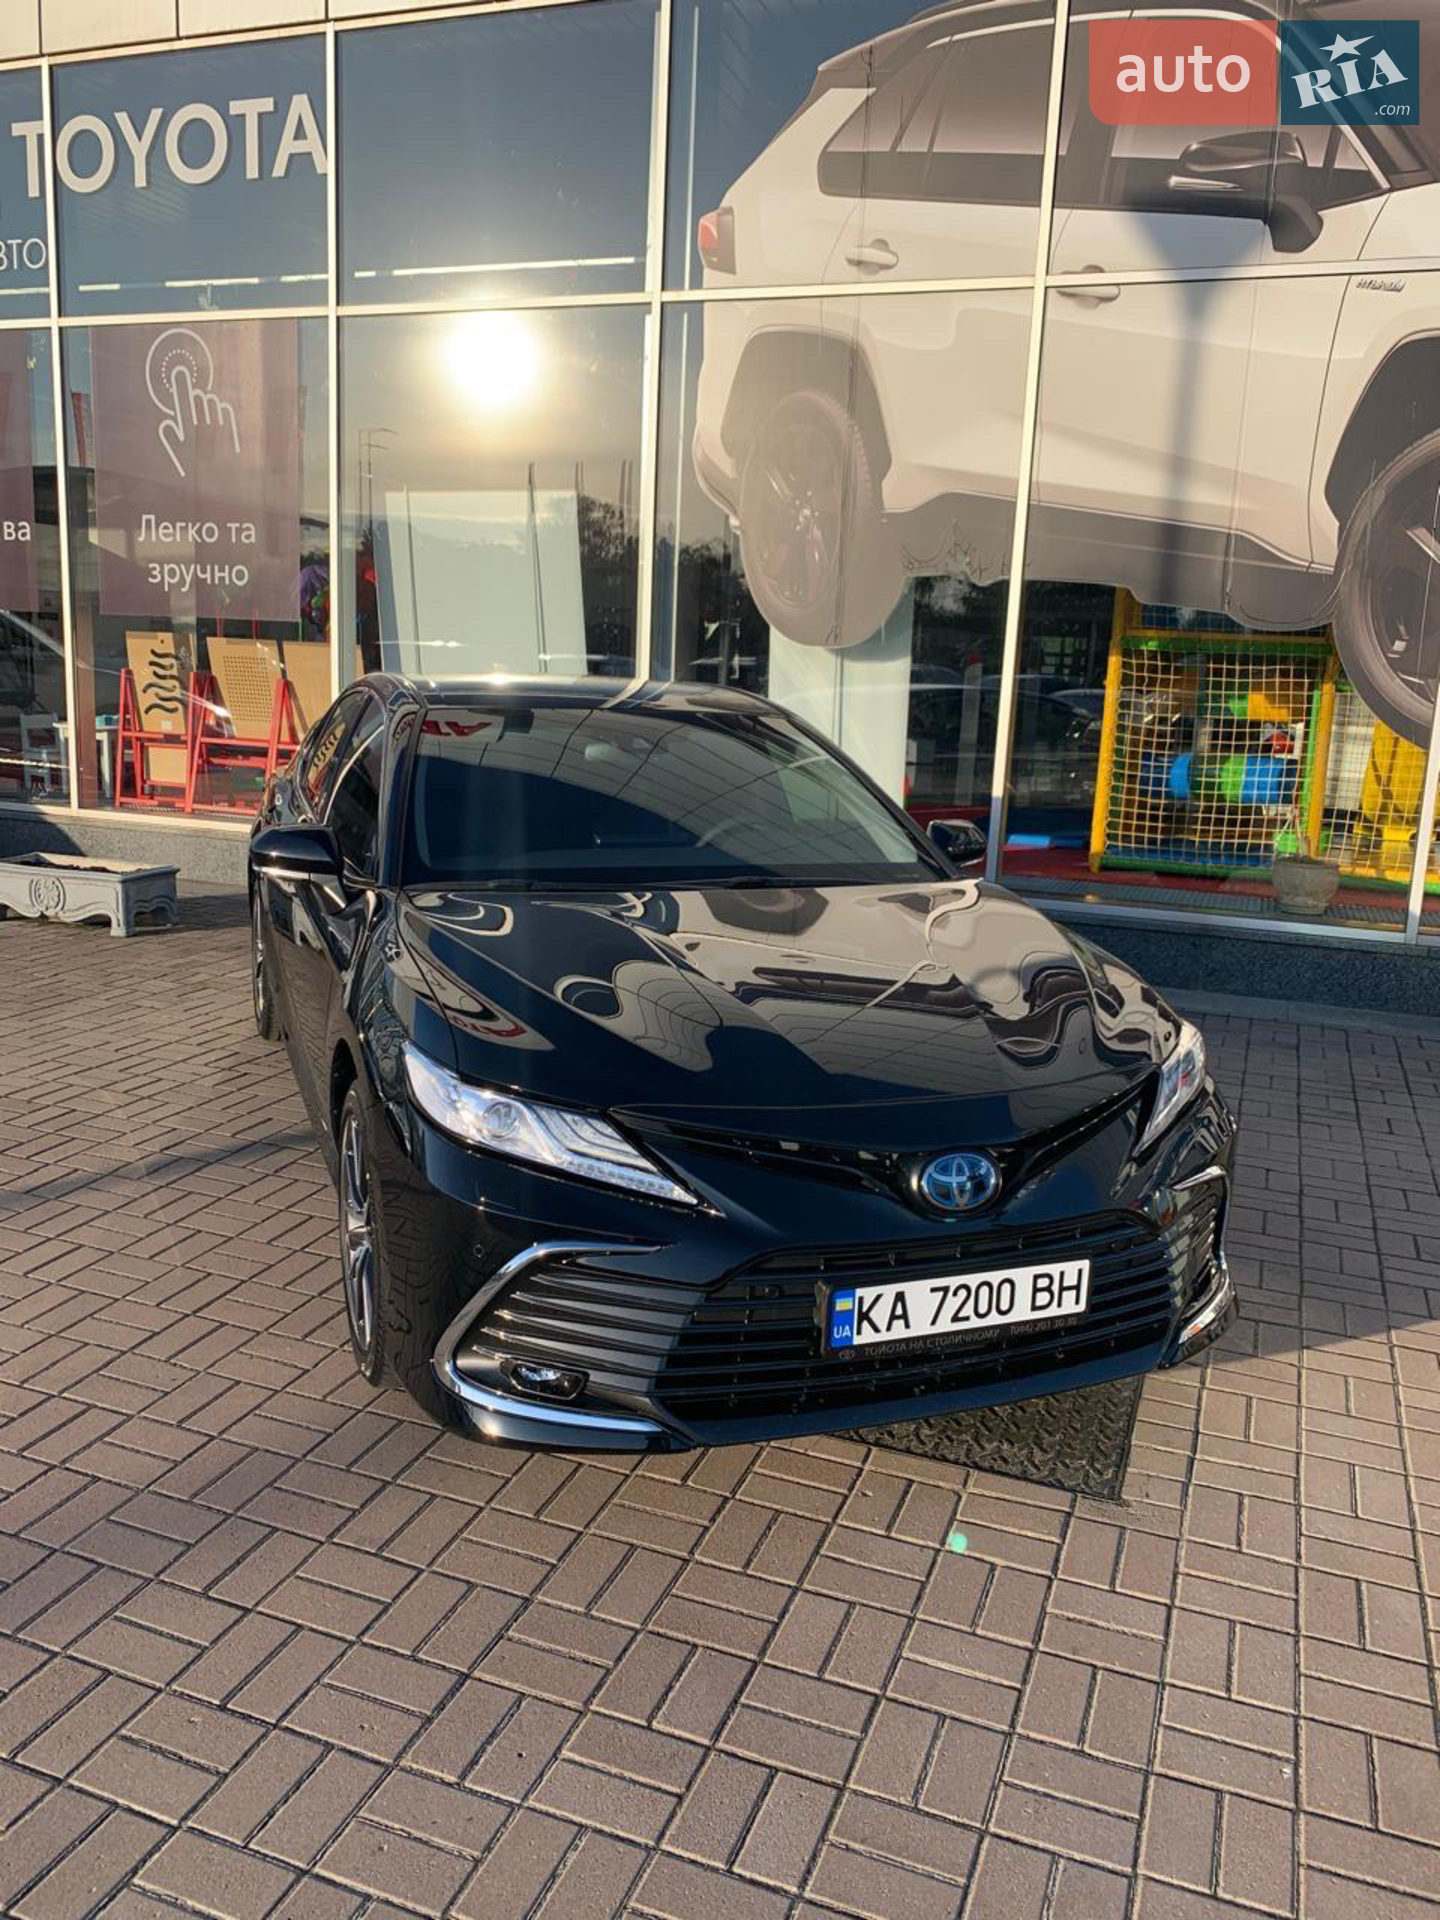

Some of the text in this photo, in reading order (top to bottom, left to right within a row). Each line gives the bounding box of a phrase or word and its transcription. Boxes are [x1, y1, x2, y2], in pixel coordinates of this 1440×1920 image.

[11, 93, 328, 198] TOYOTA
[138, 514, 256, 543] Легко та
[148, 562, 249, 591] зручно
[856, 1267, 1083, 1336] KA 7200 BH
[833, 1325, 852, 1339] UA
